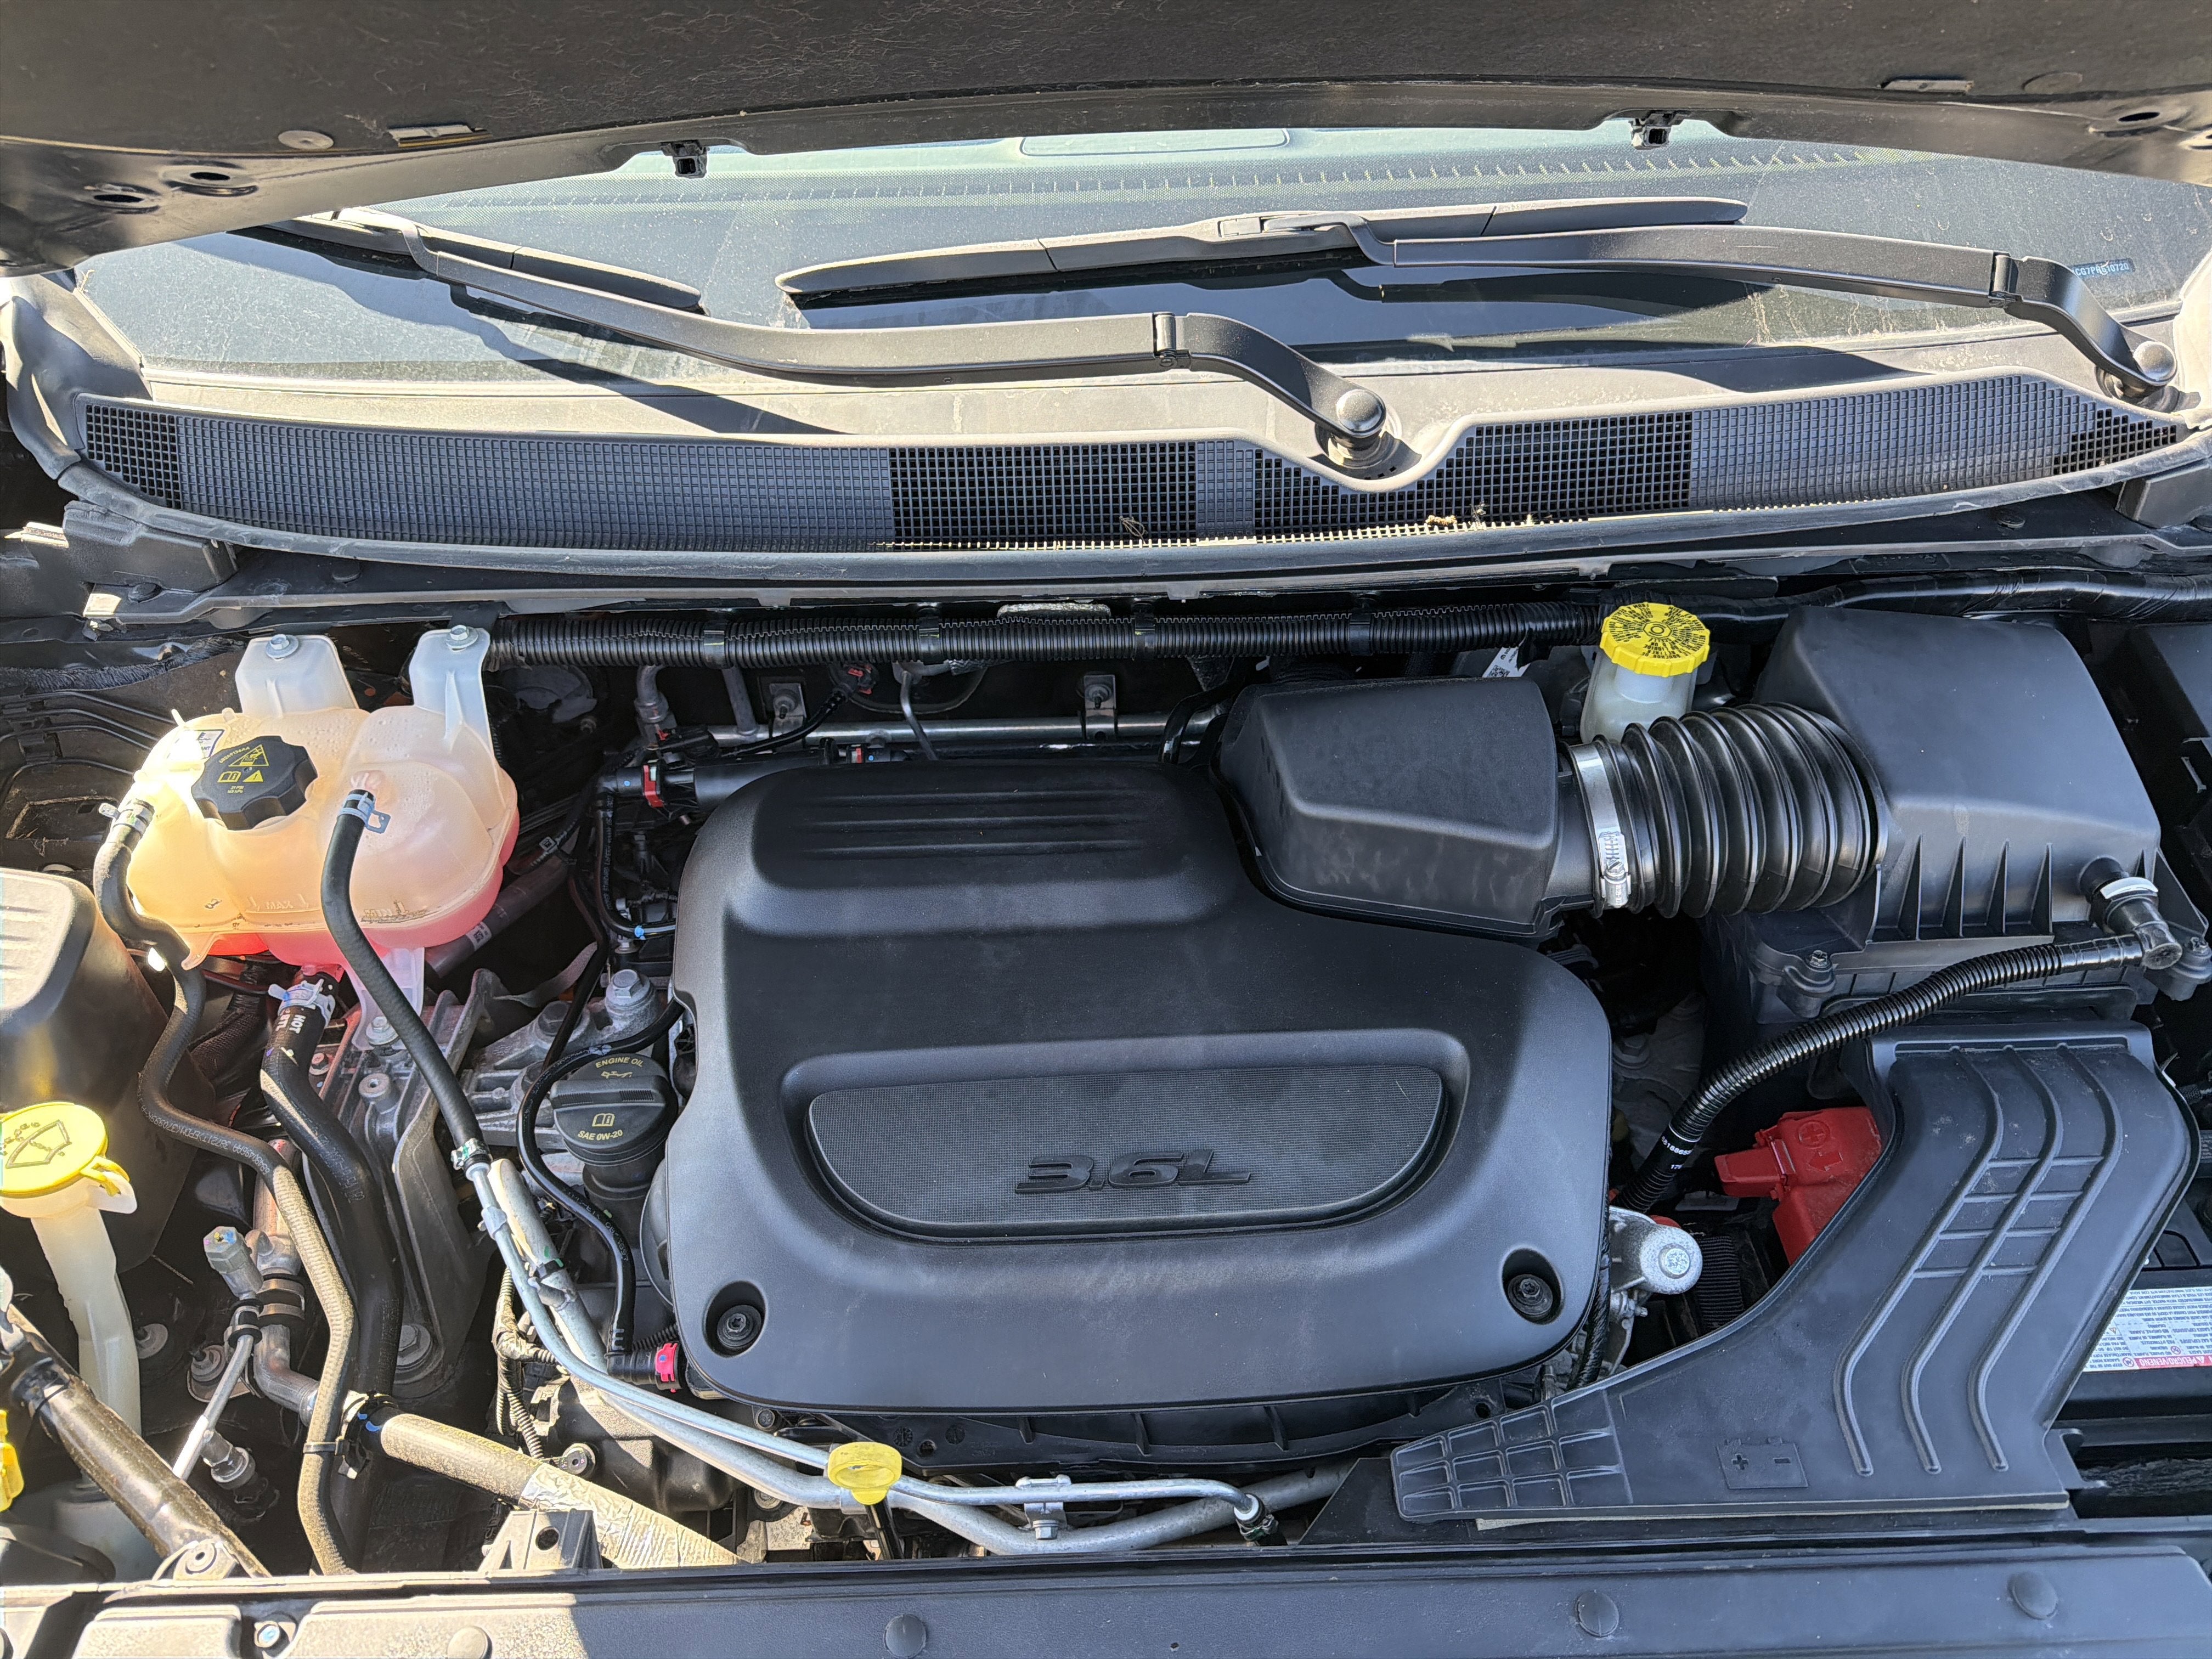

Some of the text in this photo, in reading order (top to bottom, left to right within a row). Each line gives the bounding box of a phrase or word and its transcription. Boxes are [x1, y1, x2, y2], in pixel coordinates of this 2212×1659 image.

[289, 1014, 306, 1034] HOT
[595, 1057, 644, 1069] ENGINE OIL
[578, 1130, 596, 1141] SAE
[1015, 1149, 1251, 1194] 3.6L
[2139, 1356, 2197, 1365] PELIGRO/VENENO
